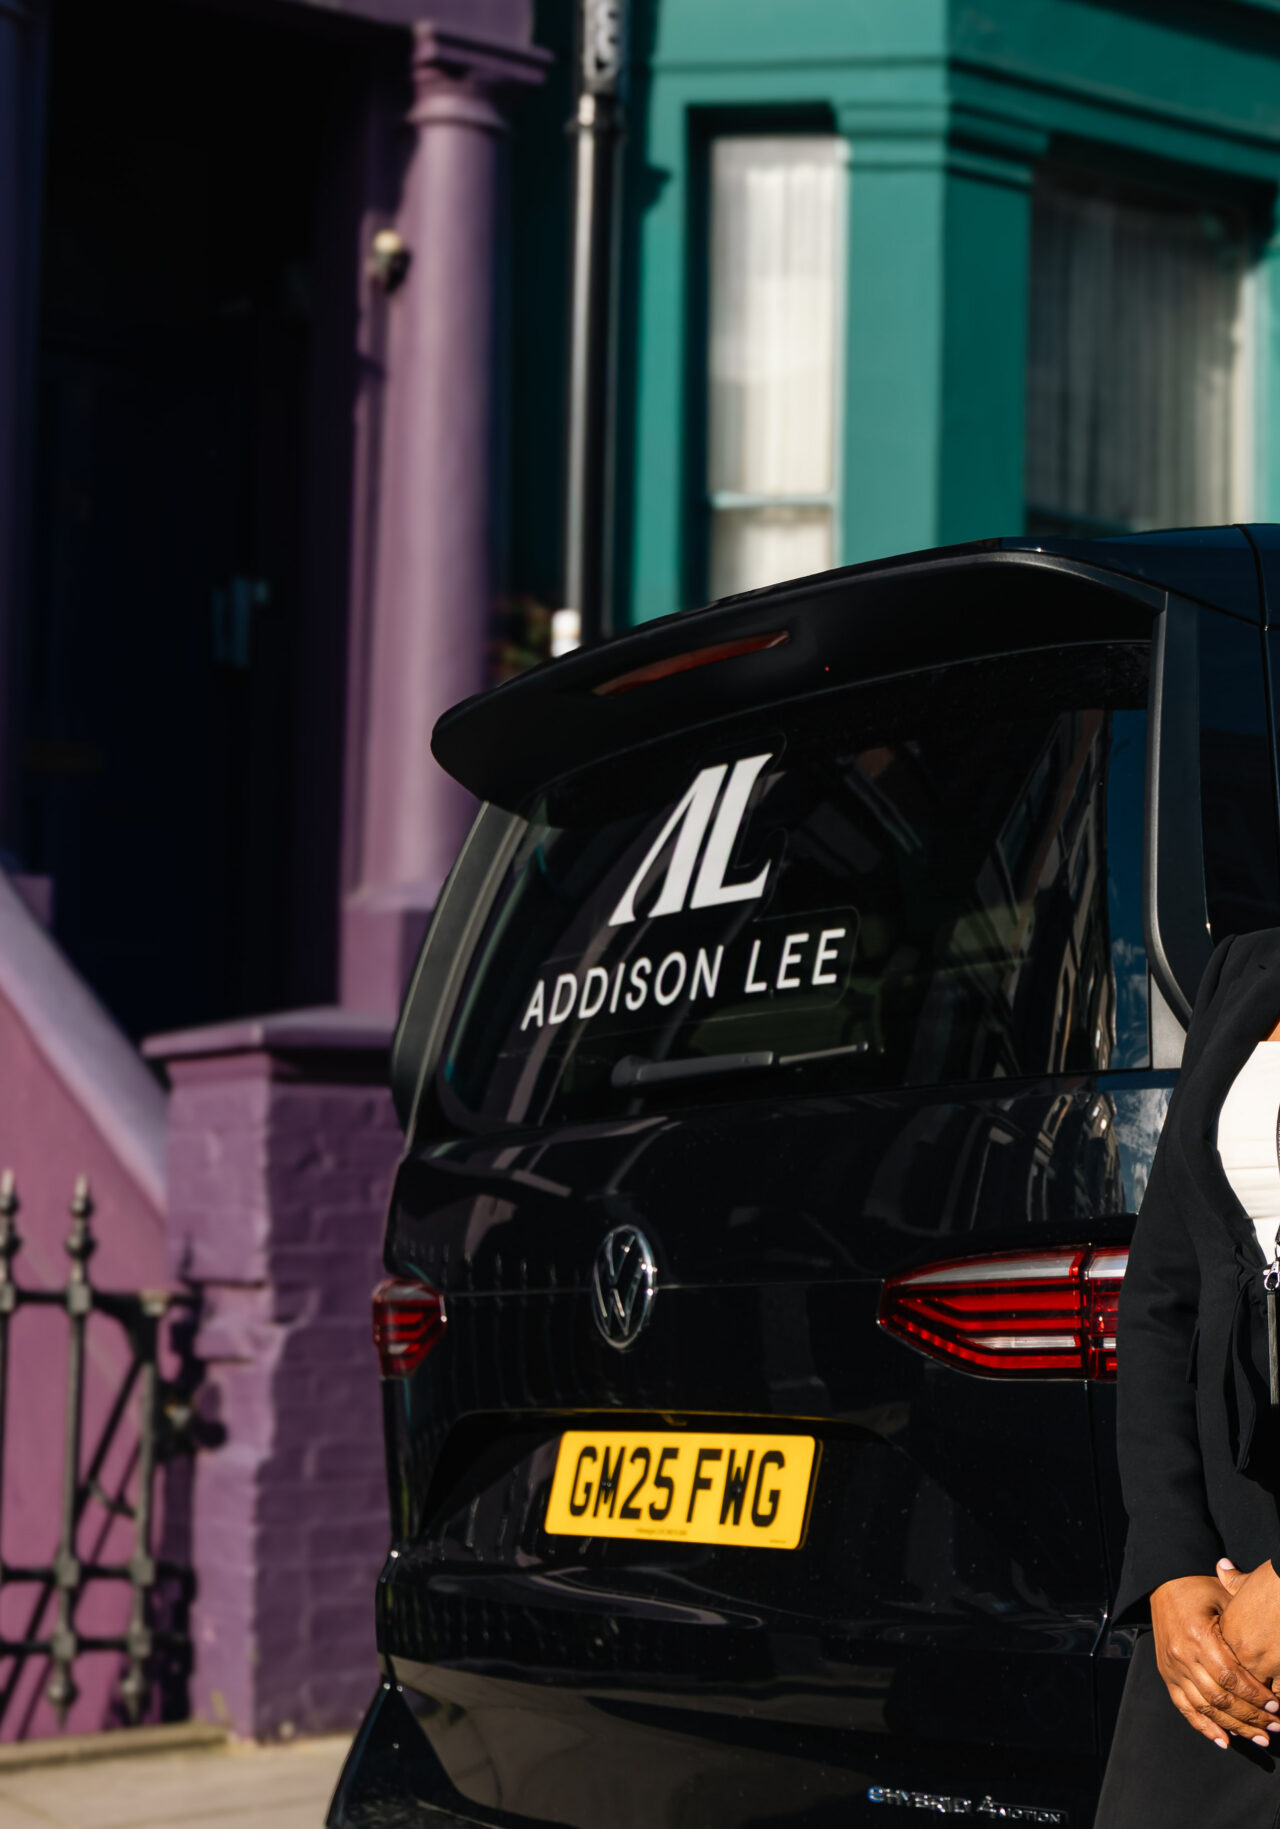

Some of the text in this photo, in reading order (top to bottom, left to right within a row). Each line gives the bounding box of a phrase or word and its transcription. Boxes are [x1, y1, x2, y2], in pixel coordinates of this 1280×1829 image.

[519, 927, 847, 1031] ADDISON LEE
[568, 1445, 786, 1528] GM25 FWG
